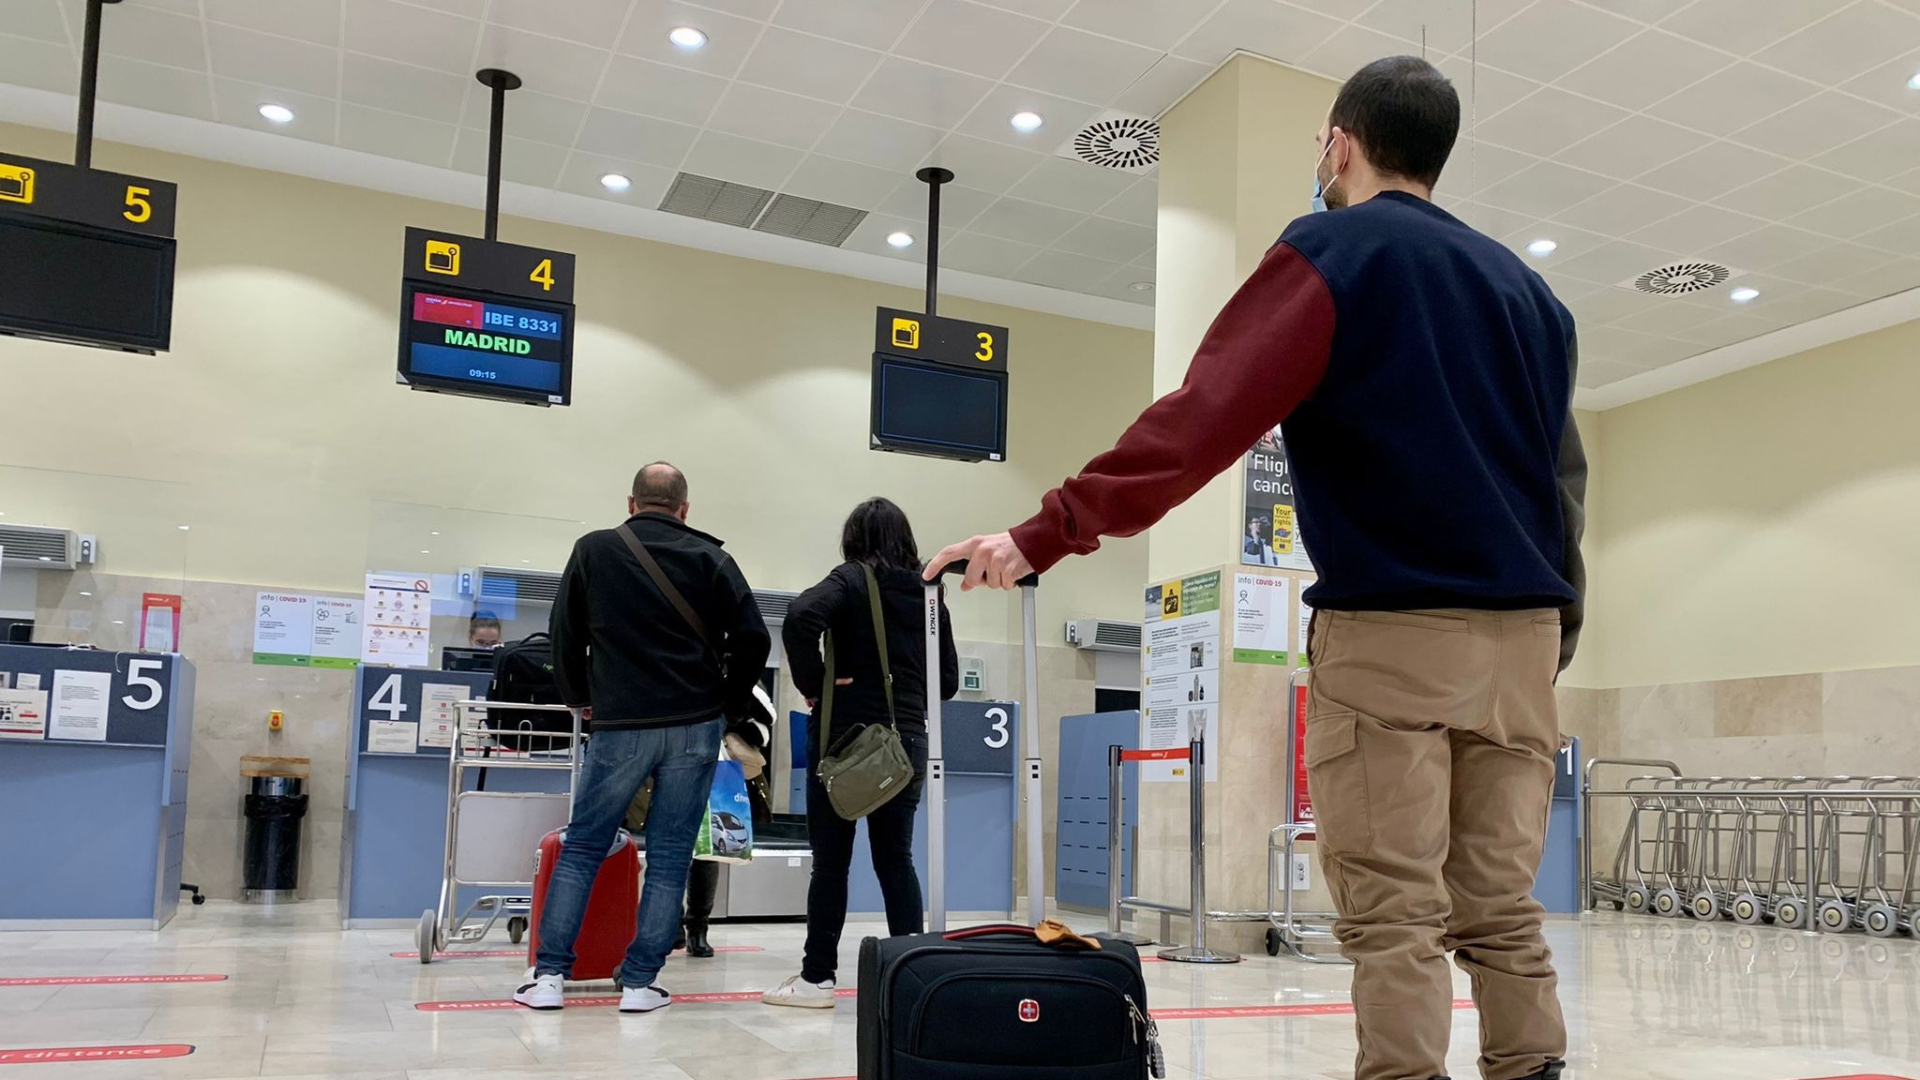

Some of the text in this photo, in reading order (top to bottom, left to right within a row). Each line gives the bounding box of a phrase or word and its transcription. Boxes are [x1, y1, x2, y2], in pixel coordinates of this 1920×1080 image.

[123, 185, 151, 223] 5
[530, 259, 555, 291] 4
[485, 311, 557, 334] IBE 8331
[444, 329, 531, 355] MADRID
[974, 331, 993, 362] 3
[469, 368, 497, 380] 09:15
[1274, 519, 1291, 527] rights
[1275, 507, 1291, 516] Your
[1237, 576, 1252, 584] info
[260, 594, 275, 602] info
[122, 659, 163, 710] 5
[368, 673, 407, 721] 4
[983, 707, 1009, 749] 3
[1560, 745, 1572, 775] 1
[24, 1047, 161, 1059] distance
